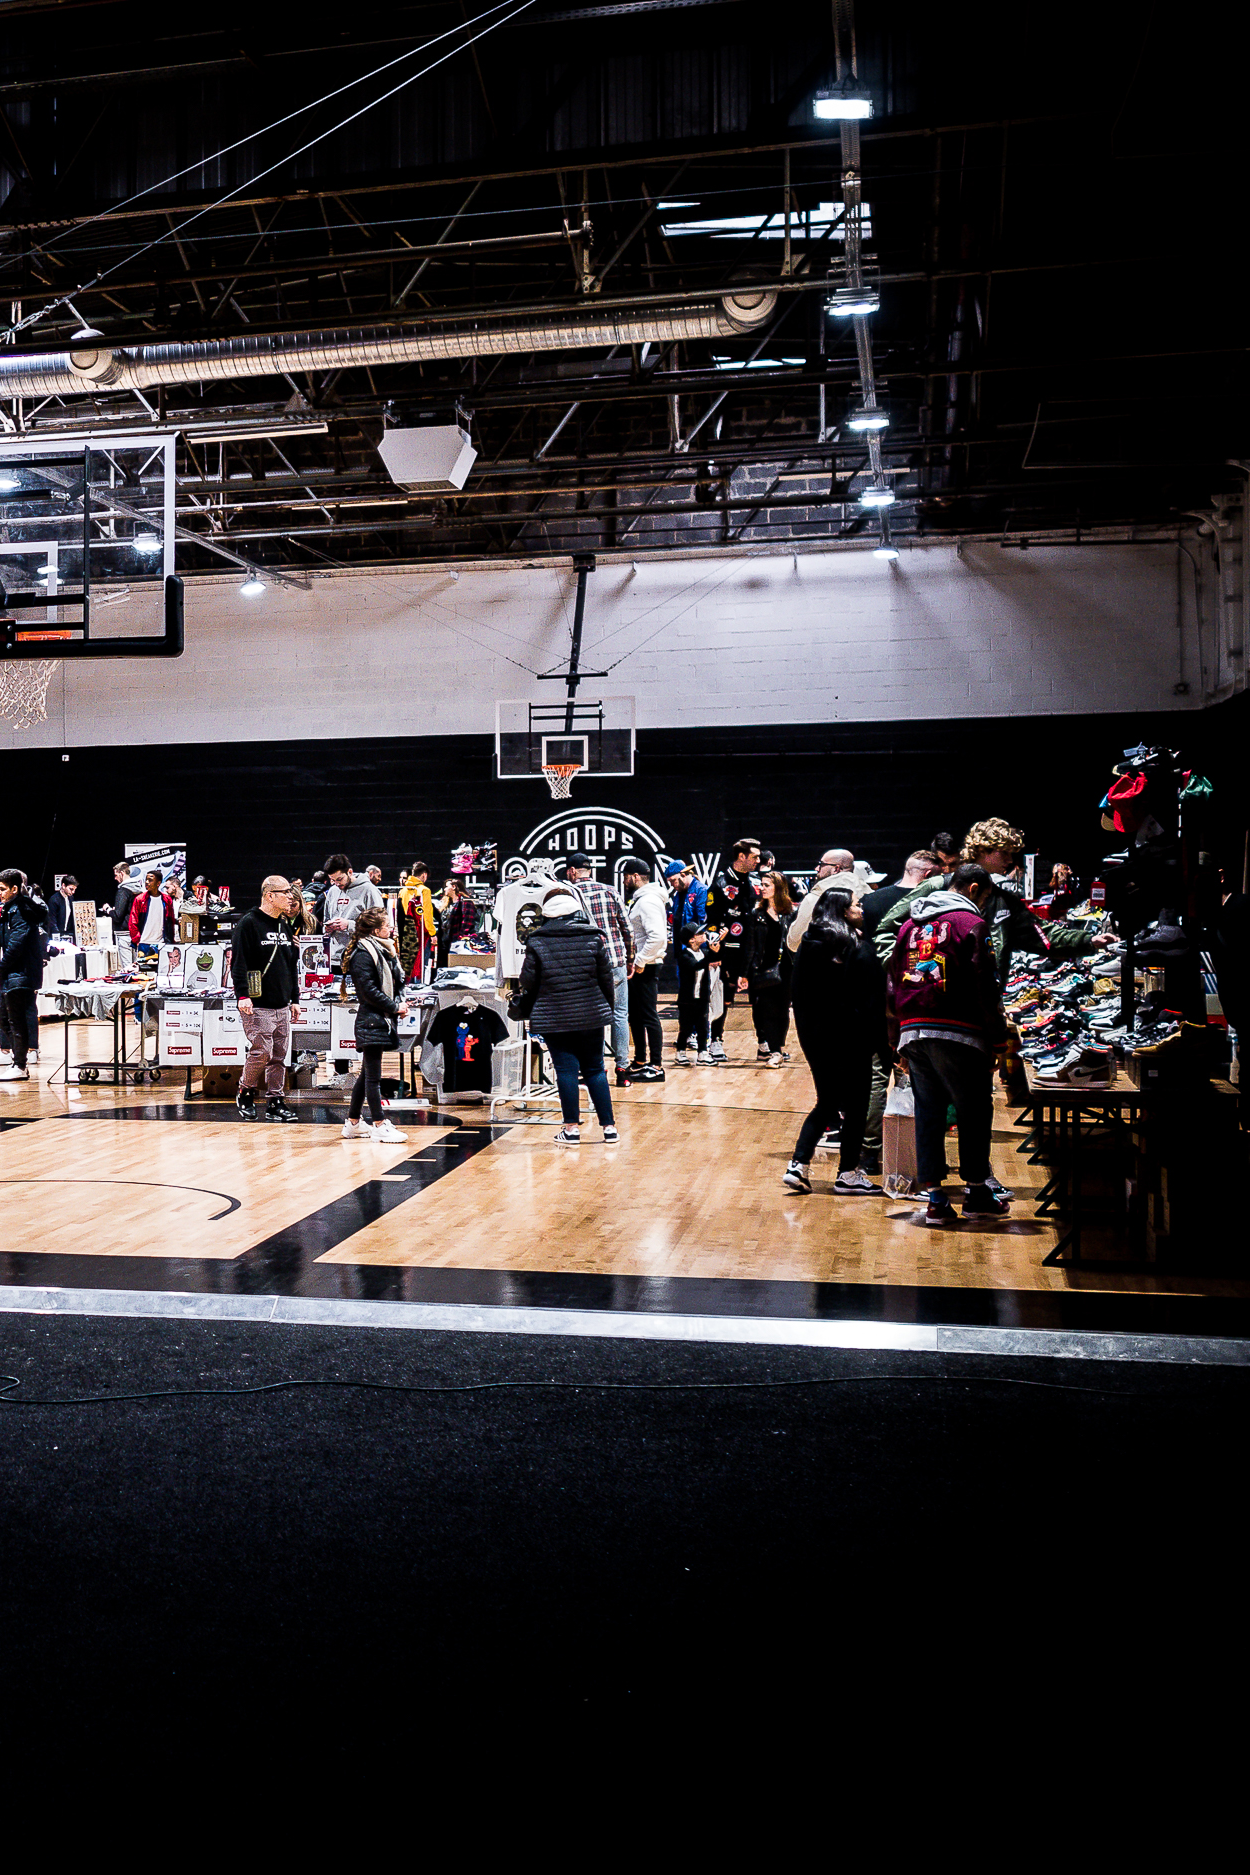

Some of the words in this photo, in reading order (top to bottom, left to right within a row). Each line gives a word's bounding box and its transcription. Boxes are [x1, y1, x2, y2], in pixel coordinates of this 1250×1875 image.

[548, 824, 634, 851] HOOPS
[922, 942, 932, 955] 13
[168, 1046, 192, 1055] Supreme
[212, 1047, 237, 1056] Supreme
